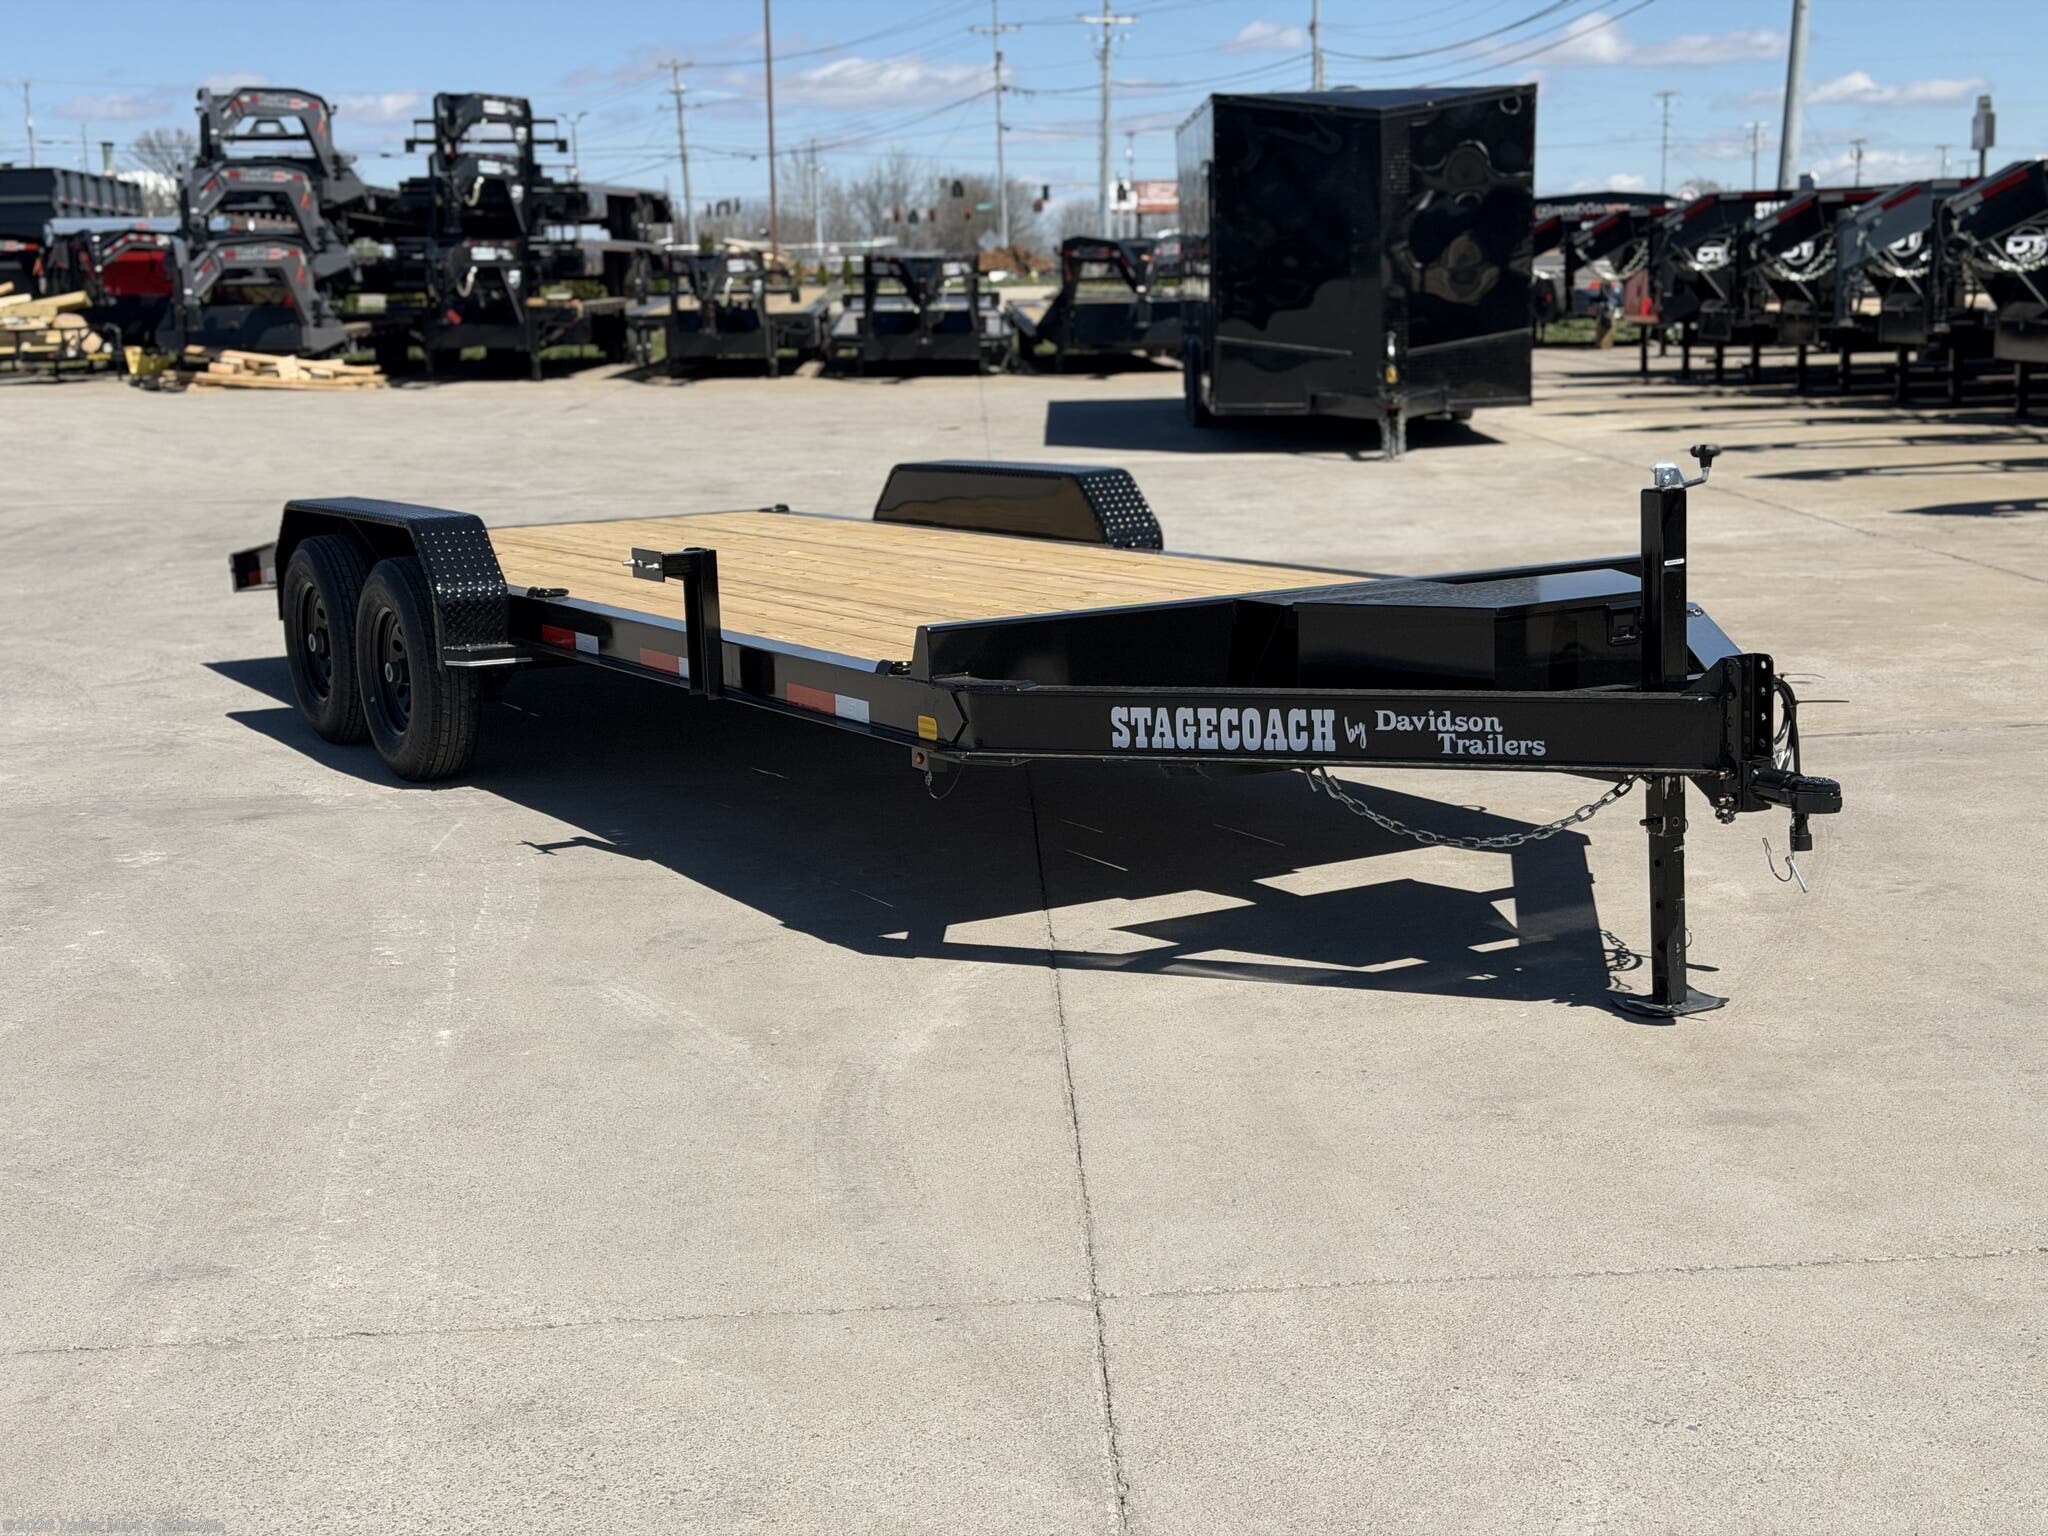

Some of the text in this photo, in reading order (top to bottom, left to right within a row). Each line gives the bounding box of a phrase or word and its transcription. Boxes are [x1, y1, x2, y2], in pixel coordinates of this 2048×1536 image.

[1112, 707, 1503, 752] STAGECOACH by Davidson
[1438, 733, 1546, 756] Trailers
